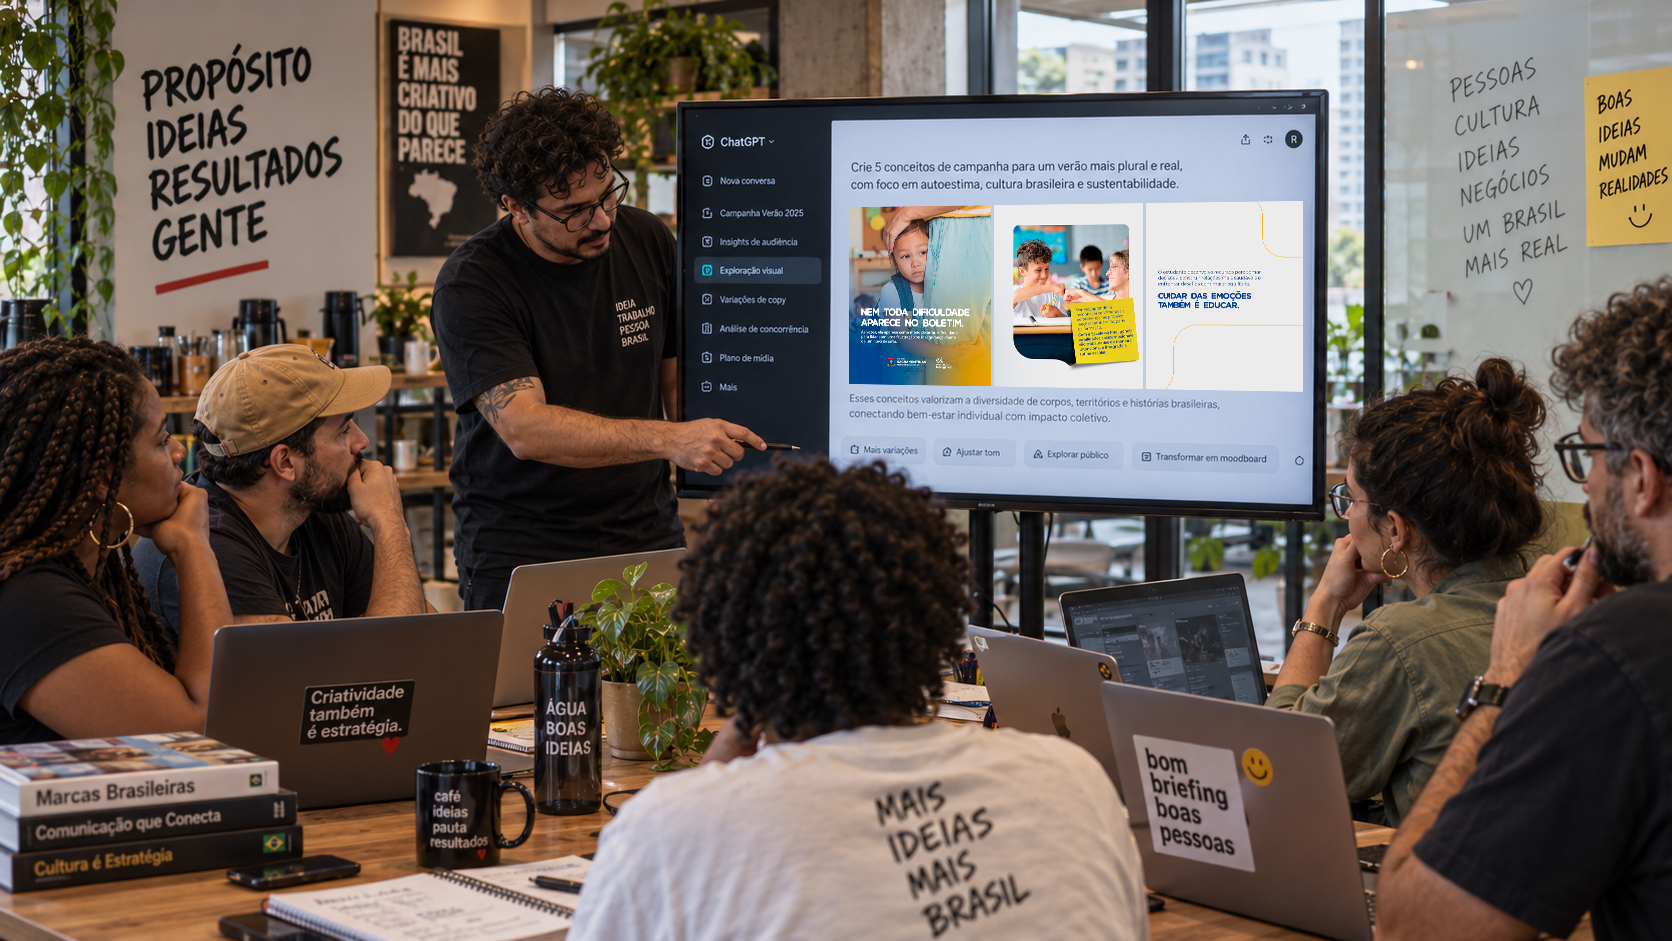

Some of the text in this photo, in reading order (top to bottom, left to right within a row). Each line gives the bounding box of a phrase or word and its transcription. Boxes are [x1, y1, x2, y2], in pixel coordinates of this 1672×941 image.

[398, 26, 464, 57] BRASIL
[398, 50, 460, 83] É MAIS
[141, 43, 312, 112] PROPÓSITO
[1450, 56, 1537, 103] PESSOAS
[398, 82, 477, 111] CRIATIVO
[1597, 89, 1633, 115] BOAS
[1454, 95, 1541, 136] CULTURA
[147, 104, 248, 161] IDEIAS
[398, 110, 461, 140] DO QUE
[1599, 116, 1641, 143] IDEIAS
[720, 136, 766, 147] ChatGPT
[1290, 135, 1298, 144] R
[398, 137, 466, 165] PARECE
[1458, 136, 1520, 173] IDEIAS
[1599, 144, 1648, 171] MUDAM
[149, 136, 343, 211] RESULTADOS
[851, 160, 1183, 175] Crie 5 conceitos de campanha para um verão mais plural e real,
[720, 177, 776, 186] Nova conversa
[851, 178, 1180, 192] com foco em autoestima, cultura brasileira e sustentabilidade.
[1460, 164, 1550, 207] NEGÓCIOS
[1599, 166, 1669, 199] REALIDADES
[720, 208, 804, 218] Campanha Verão 2025
[1463, 200, 1566, 244] UM BRASIL
[152, 200, 268, 262] GENTE
[720, 238, 798, 248] Insights de audiência
[1465, 234, 1568, 278] MAIS REAL
[720, 266, 784, 276] Exploração visual
[720, 295, 786, 306] Variações de copy
[1158, 290, 1252, 302] CUIDAR DAS EMOÇÕES
[1158, 300, 1191, 309] TAMBÉM
[1194, 300, 1200, 309] É
[615, 299, 636, 312] IDEIA
[860, 308, 970, 317] NEM TODA DIFICULDADE
[617, 306, 656, 324] TRABALHO
[860, 318, 964, 328] APARECE NO BOLETIM.
[620, 320, 650, 336] PESSOA
[720, 324, 809, 334] Análise de concorrência
[622, 333, 650, 347] BRASIL
[720, 354, 741, 362] Plano
[742, 354, 752, 362] de
[720, 383, 738, 392] Mais
[850, 394, 874, 404] Esses
[876, 394, 920, 404] conceitos
[921, 395, 964, 405] valorizam
[972, 396, 1024, 406] diversidade
[1026, 396, 1038, 406] de
[1040, 398, 1074, 409] corpos,
[1076, 398, 1120, 408] territórios
[1122, 400, 1128, 408] e
[1130, 398, 1170, 408] histórias
[1171, 399, 1220, 410] brasileiras,
[850, 410, 1111, 423] conectando bem-estar individual com impacto coletivo.
[864, 446, 918, 456] Mais variações
[956, 448, 1000, 458] Ajustar tom
[1047, 450, 1109, 460] Explorar público
[1156, 452, 1267, 464] Transformar em moodboard
[311, 684, 404, 705] Criatividade
[309, 704, 375, 722] também
[546, 698, 587, 716] ÁGUA
[307, 718, 402, 739] é estratégia.
[546, 721, 586, 736] BOAS
[546, 740, 591, 756] IDEIAS
[1145, 747, 1188, 776] bom
[36, 778, 196, 807] Marcas Brasileiras
[434, 788, 462, 803] café
[1150, 772, 1229, 811] briefing
[432, 804, 468, 818] ideias
[874, 780, 947, 828] MAIS
[1154, 796, 1202, 825] boas
[35, 810, 222, 841] Comunicação que Conecta
[432, 820, 468, 836] pauta
[430, 834, 488, 850] resultados
[887, 806, 994, 864] IDEIAS
[1160, 825, 1236, 856] pessoas
[34, 848, 173, 877] Cultura é Estratégia
[906, 848, 978, 901] MAIS
[920, 872, 1032, 939] BRASIL
